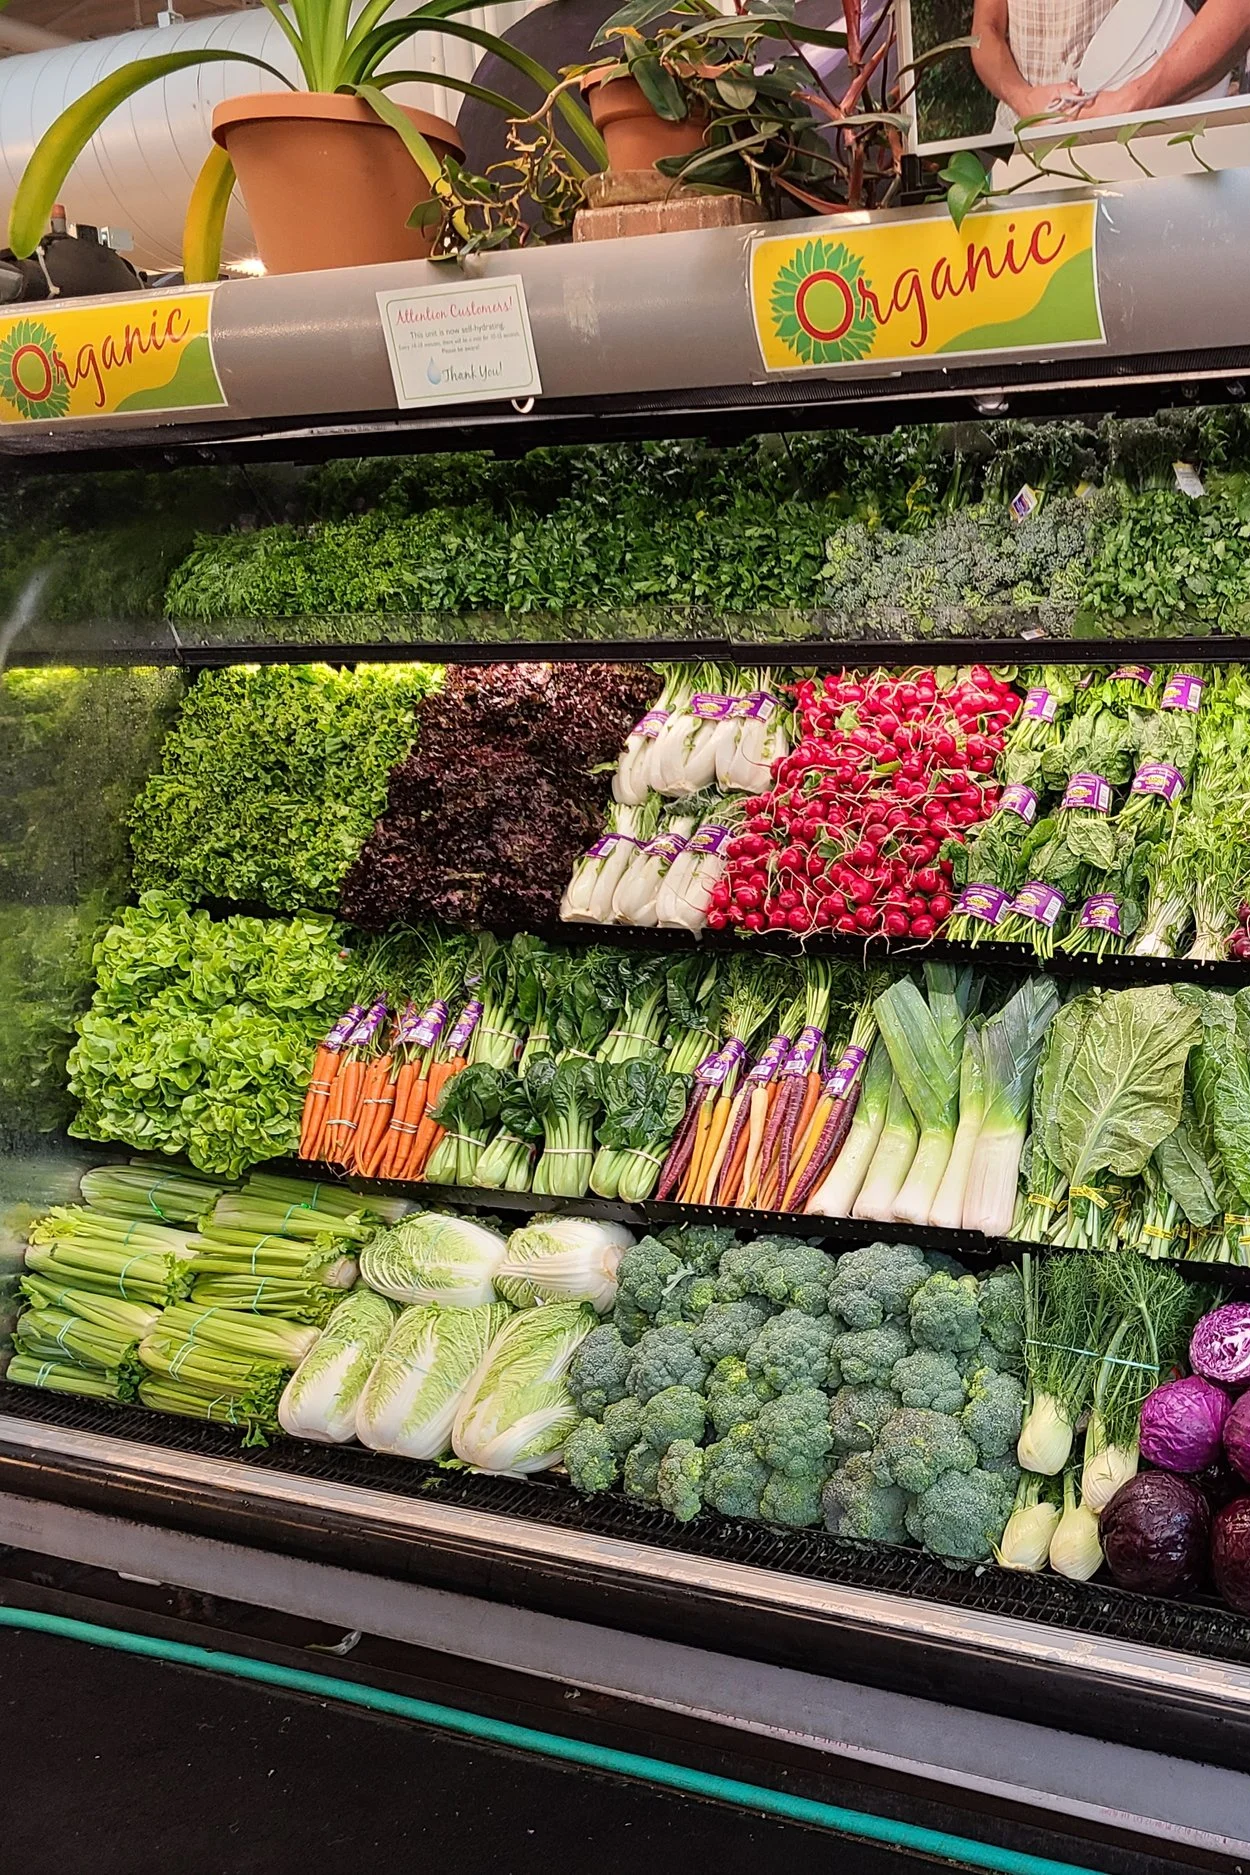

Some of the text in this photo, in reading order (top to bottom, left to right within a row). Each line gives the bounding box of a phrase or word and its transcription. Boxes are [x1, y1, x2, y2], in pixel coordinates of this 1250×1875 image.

[796, 220, 1066, 348] Organic
[396, 296, 512, 325] Attention Customers!
[410, 330, 424, 340] This
[425, 329, 438, 338] unit
[11, 308, 191, 408] Organic
[442, 361, 502, 383] Thank You!
